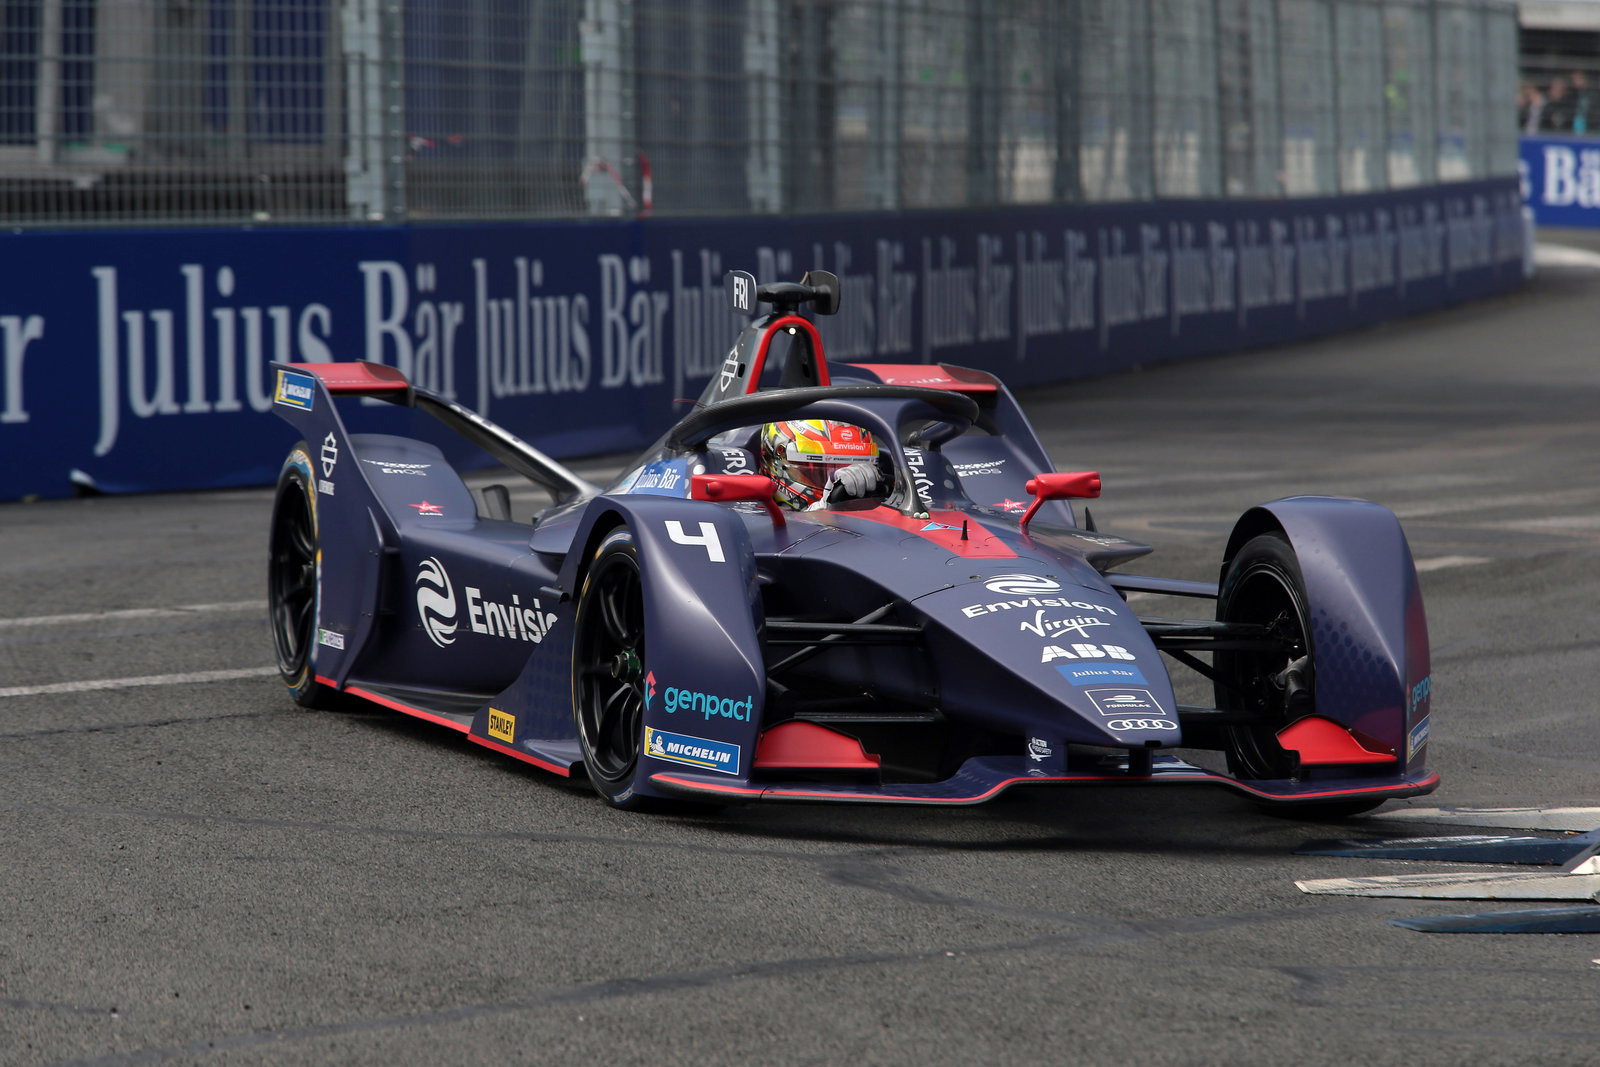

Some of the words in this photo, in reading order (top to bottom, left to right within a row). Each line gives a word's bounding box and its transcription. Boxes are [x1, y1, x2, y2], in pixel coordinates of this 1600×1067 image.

[1544, 145, 1600, 208] Bä
[733, 275, 749, 310] FRI
[472, 257, 592, 421] Julius
[599, 253, 670, 388] Bär
[91, 264, 335, 456] Julius
[358, 260, 464, 407] Bär
[659, 467, 680, 490] Bär
[664, 520, 726, 563] 4
[465, 586, 559, 644] Envisi
[961, 596, 1118, 619] Envision
[1020, 609, 1111, 639] Virgin
[1041, 643, 1136, 663] ABB
[1071, 670, 1110, 678] Julius
[664, 686, 753, 723] genpact
[490, 714, 514, 737] STANLEY
[667, 742, 732, 764] MICHELIN
